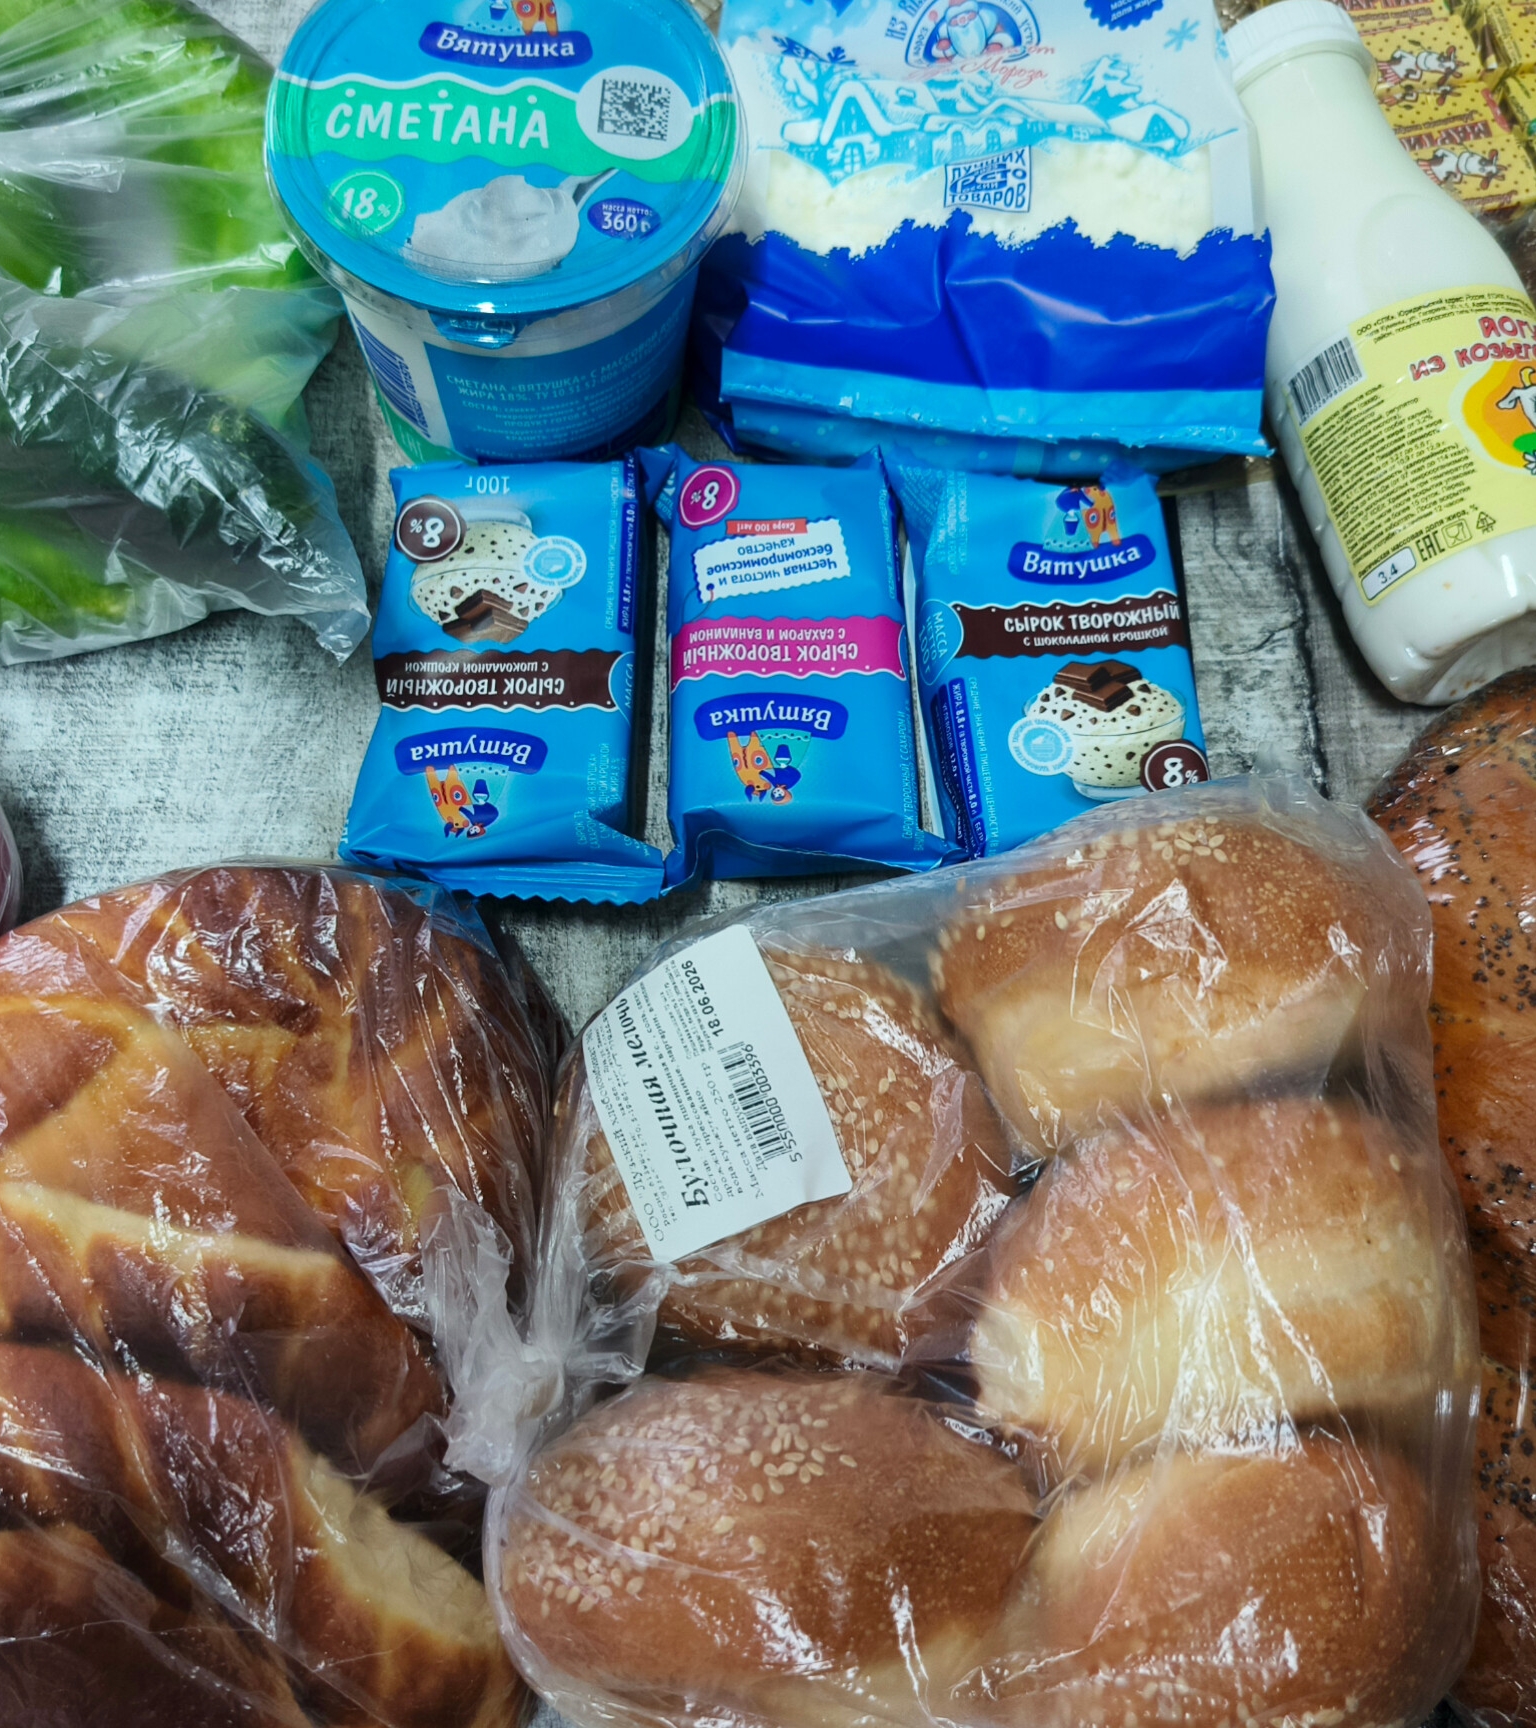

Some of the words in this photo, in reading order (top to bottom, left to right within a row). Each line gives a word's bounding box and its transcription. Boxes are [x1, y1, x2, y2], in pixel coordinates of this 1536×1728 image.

[437, 29, 575, 65] Вятушка
[961, 56, 1047, 89] Мороза
[325, 100, 549, 149] СМЕТАНА
[950, 183, 1025, 208] ТОВАРОВ
[601, 212, 637, 232] 360
[1409, 354, 1446, 381] ИЗ
[446, 374, 507, 392] СМЕТАНА
[512, 376, 586, 392] «ВЯТУШКА»
[458, 386, 495, 401] ЖИРА
[536, 390, 548, 400] ТУ
[464, 475, 472, 488] г
[476, 475, 510, 495] 100
[689, 480, 719, 510] 8%
[410, 516, 444, 547] 8%
[736, 522, 752, 532] лет!
[754, 522, 769, 532] 100
[772, 520, 795, 531] Скоро
[1388, 527, 1424, 551] массовая
[1424, 518, 1446, 533] доля
[706, 543, 833, 576] бескомпромиссное
[737, 537, 796, 556] качество
[1022, 544, 1142, 577] Вятушка
[604, 554, 618, 595] ЗНАЧЕНИЯ
[730, 568, 780, 583] чистота
[782, 557, 837, 575] Честная
[1377, 563, 1401, 584] 3.4
[717, 576, 727, 586] и
[603, 595, 616, 630] СРЕДНИЕ
[1003, 614, 1065, 634] СЫРОК
[1068, 602, 1180, 630] ТВОРОЖНЫЙ
[689, 627, 762, 643] ВАНИЛИНОМ
[765, 628, 775, 640] И
[778, 628, 834, 640] САХАРОМ
[837, 627, 845, 638] С
[932, 610, 948, 659] МАССА
[1023, 636, 1031, 647] С
[1033, 630, 1110, 648] ШОКОЛАДНОЙ
[1112, 626, 1169, 643] КРОШКОЙ
[683, 643, 790, 668] ТВОРОЖНЫЙ
[796, 643, 858, 661] СЫРОК
[404, 660, 460, 675] КРОШКОЙ
[461, 660, 537, 674] ШОКОЛАДНОЙ
[541, 661, 548, 672] С
[386, 678, 496, 696] ТВОРОЖНЫЙ
[503, 677, 564, 695] СЫРОК
[968, 676, 980, 710] СРЕДНИЕ
[710, 697, 831, 734] Вятушка
[955, 708, 965, 723] 8,8
[960, 737, 971, 773] ТВОРОЖНОЙ
[973, 713, 987, 751] ЗНАЧЕНИЯ
[410, 734, 530, 766] Вятушка
[979, 753, 994, 792] ПИЩЕВОЙ
[1162, 757, 1199, 788] 8%
[899, 763, 913, 812] ТВОРОЖНЫЙ
[900, 814, 914, 839] СЫРОК
[985, 793, 998, 837] ЦЕННОСТИ
[681, 960, 723, 1036] 18.06.2026
[608, 998, 651, 1067] мелочь
[652, 1014, 675, 1062] маргарин,
[701, 1062, 711, 1077] гр
[741, 1044, 771, 1093] 003396
[661, 1061, 689, 1120] пшеничная
[706, 1080, 723, 1104] 250
[675, 1068, 711, 1145] прессованные,
[722, 1108, 742, 1147] нетто
[765, 1097, 796, 1149] 550000
[642, 1076, 708, 1206] Булочная
[687, 1124, 702, 1151] мука
[749, 1142, 768, 1170] Дата
[788, 1151, 802, 1162] 5
[739, 1150, 763, 1198] Масса
[643, 1202, 664, 1241] ООО
